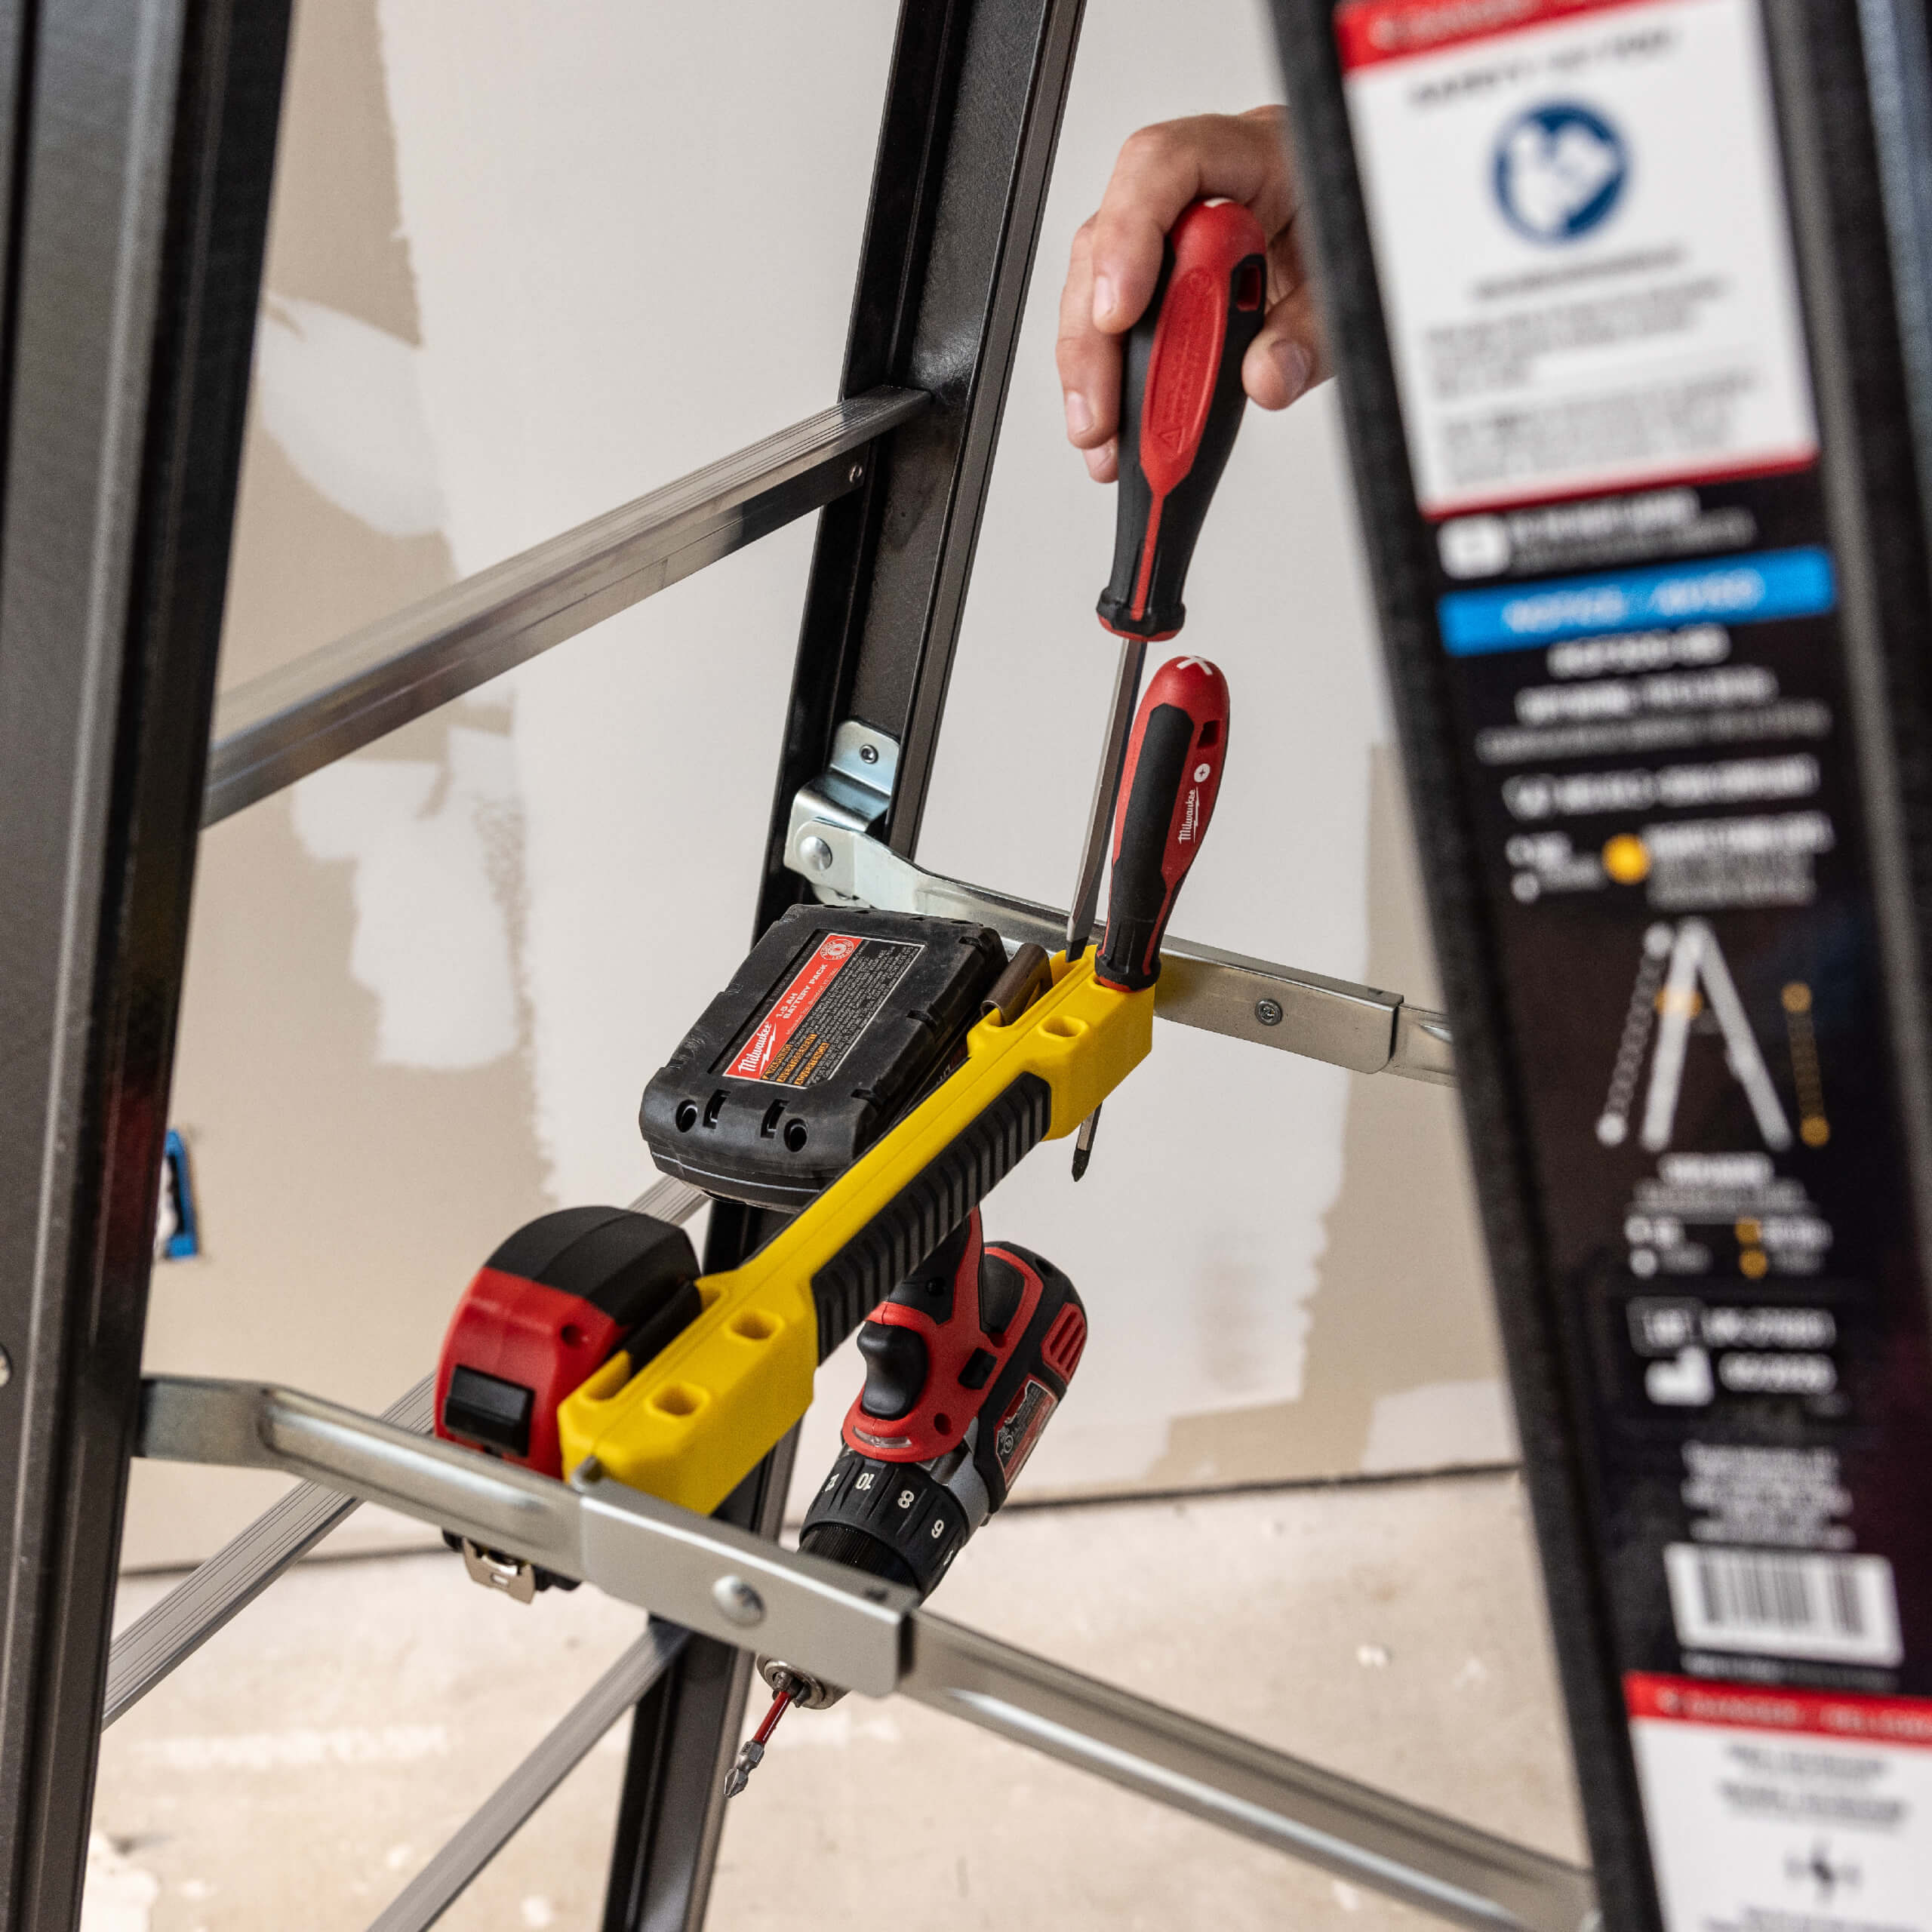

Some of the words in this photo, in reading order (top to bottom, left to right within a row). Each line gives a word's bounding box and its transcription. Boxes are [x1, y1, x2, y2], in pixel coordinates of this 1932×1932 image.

[1178, 789, 1195, 844] Milwaukee
[776, 1005, 789, 1018] 1.5
[786, 992, 798, 1005] AH
[783, 986, 812, 1019] BATTERY
[808, 964, 829, 985] PACK
[738, 1022, 771, 1073] Milwaukee
[897, 1490, 915, 1509] 8
